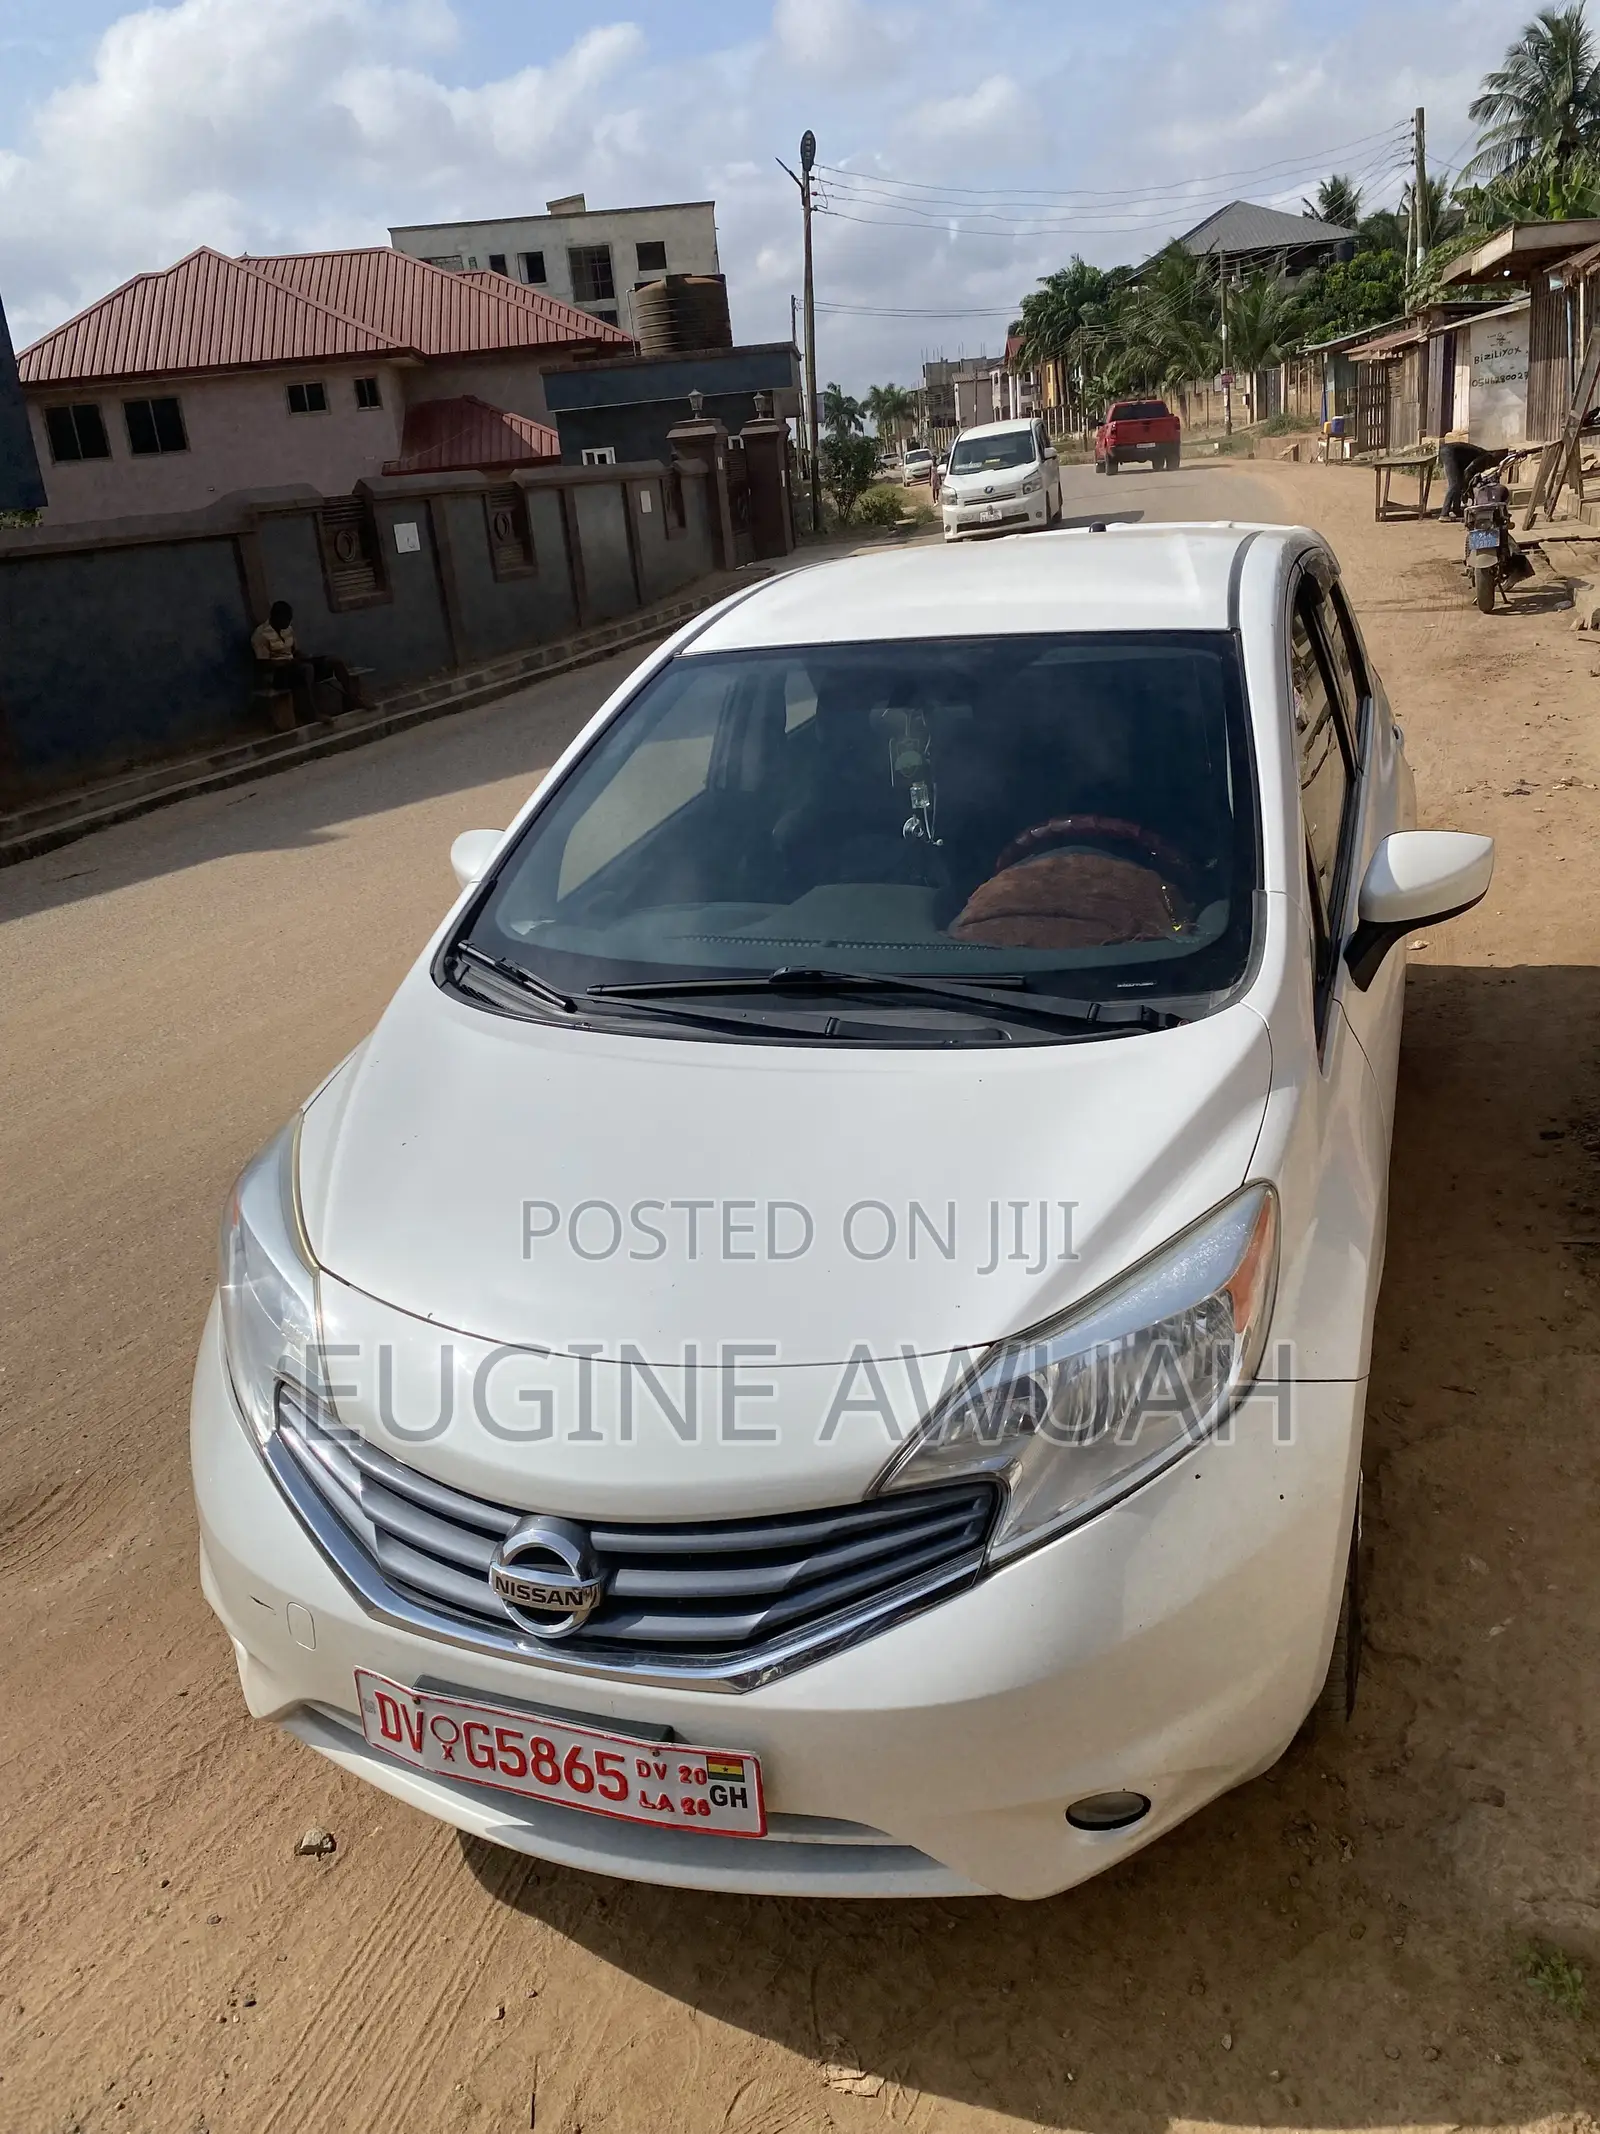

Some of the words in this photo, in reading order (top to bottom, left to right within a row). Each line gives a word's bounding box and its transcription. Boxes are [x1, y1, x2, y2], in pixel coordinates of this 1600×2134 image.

[494, 1575, 584, 1606] NISSAN
[374, 1690, 424, 1754] DV
[462, 1721, 629, 1802] G5865
[635, 1758, 668, 1781] DV
[678, 1764, 708, 1786] 20
[639, 1789, 676, 1813] LA
[709, 1784, 748, 1809] GH
